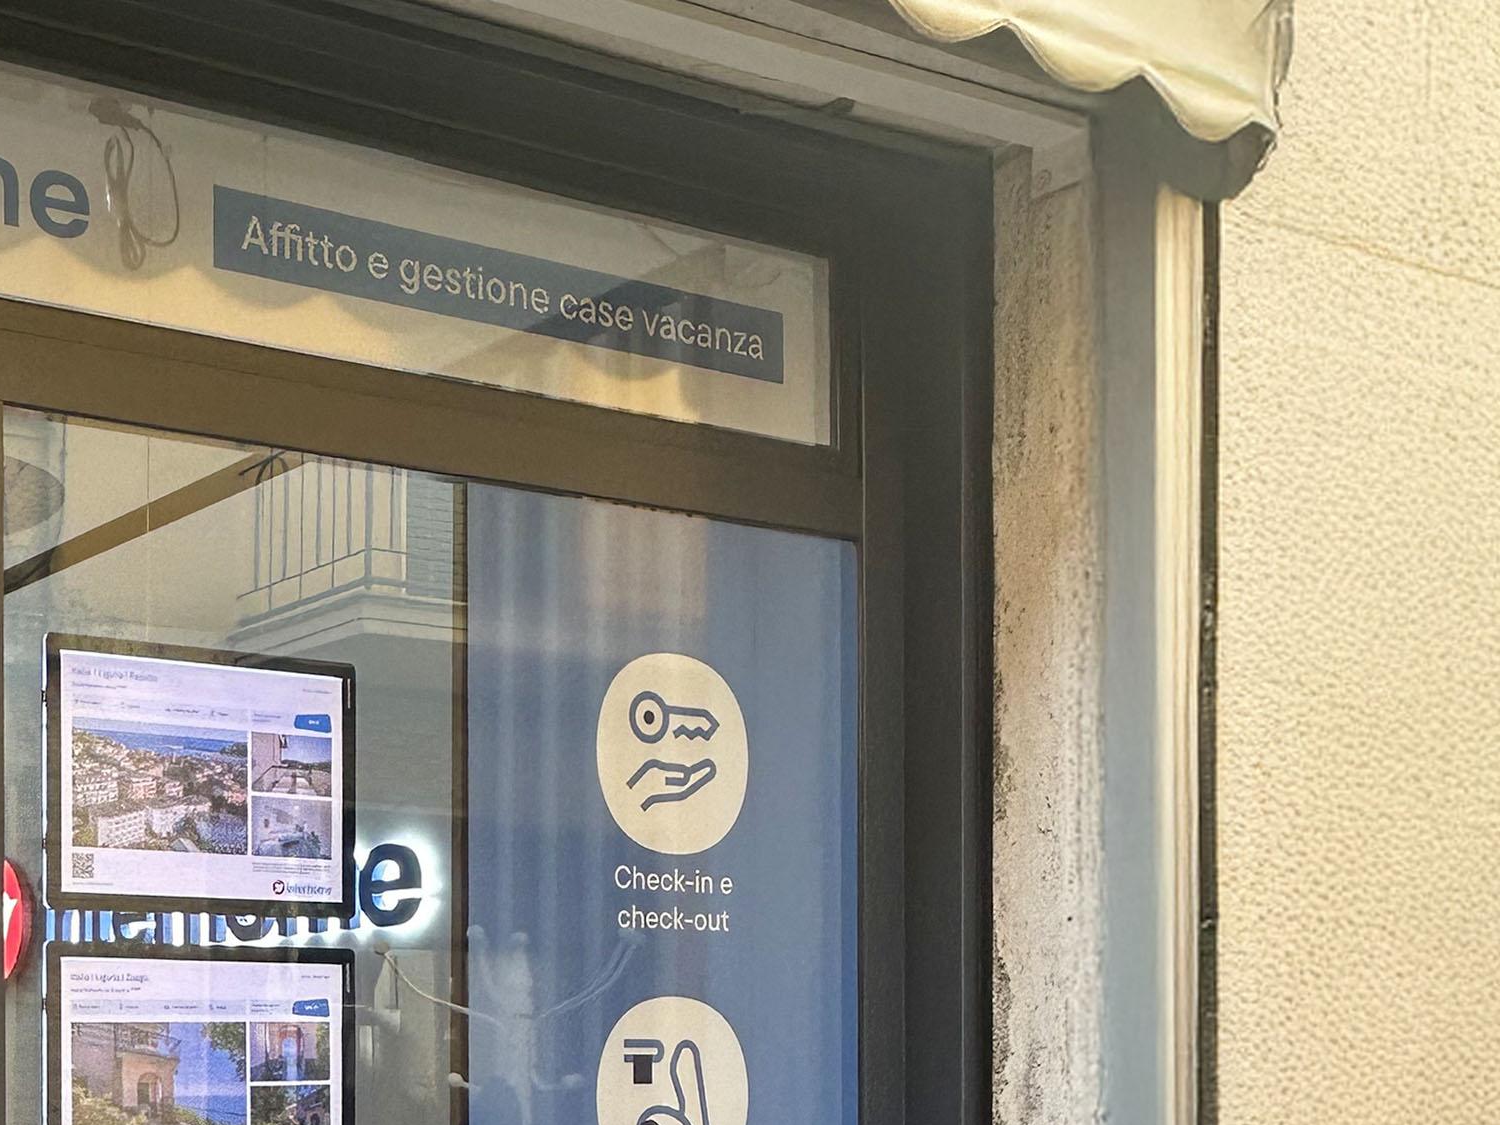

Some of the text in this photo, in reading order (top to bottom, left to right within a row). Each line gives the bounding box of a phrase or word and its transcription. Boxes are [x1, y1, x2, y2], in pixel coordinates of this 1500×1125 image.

[241, 215, 765, 361] Affitto e gestione case vacanza
[614, 865, 734, 895] Check-in e
[617, 904, 730, 933] check-out
